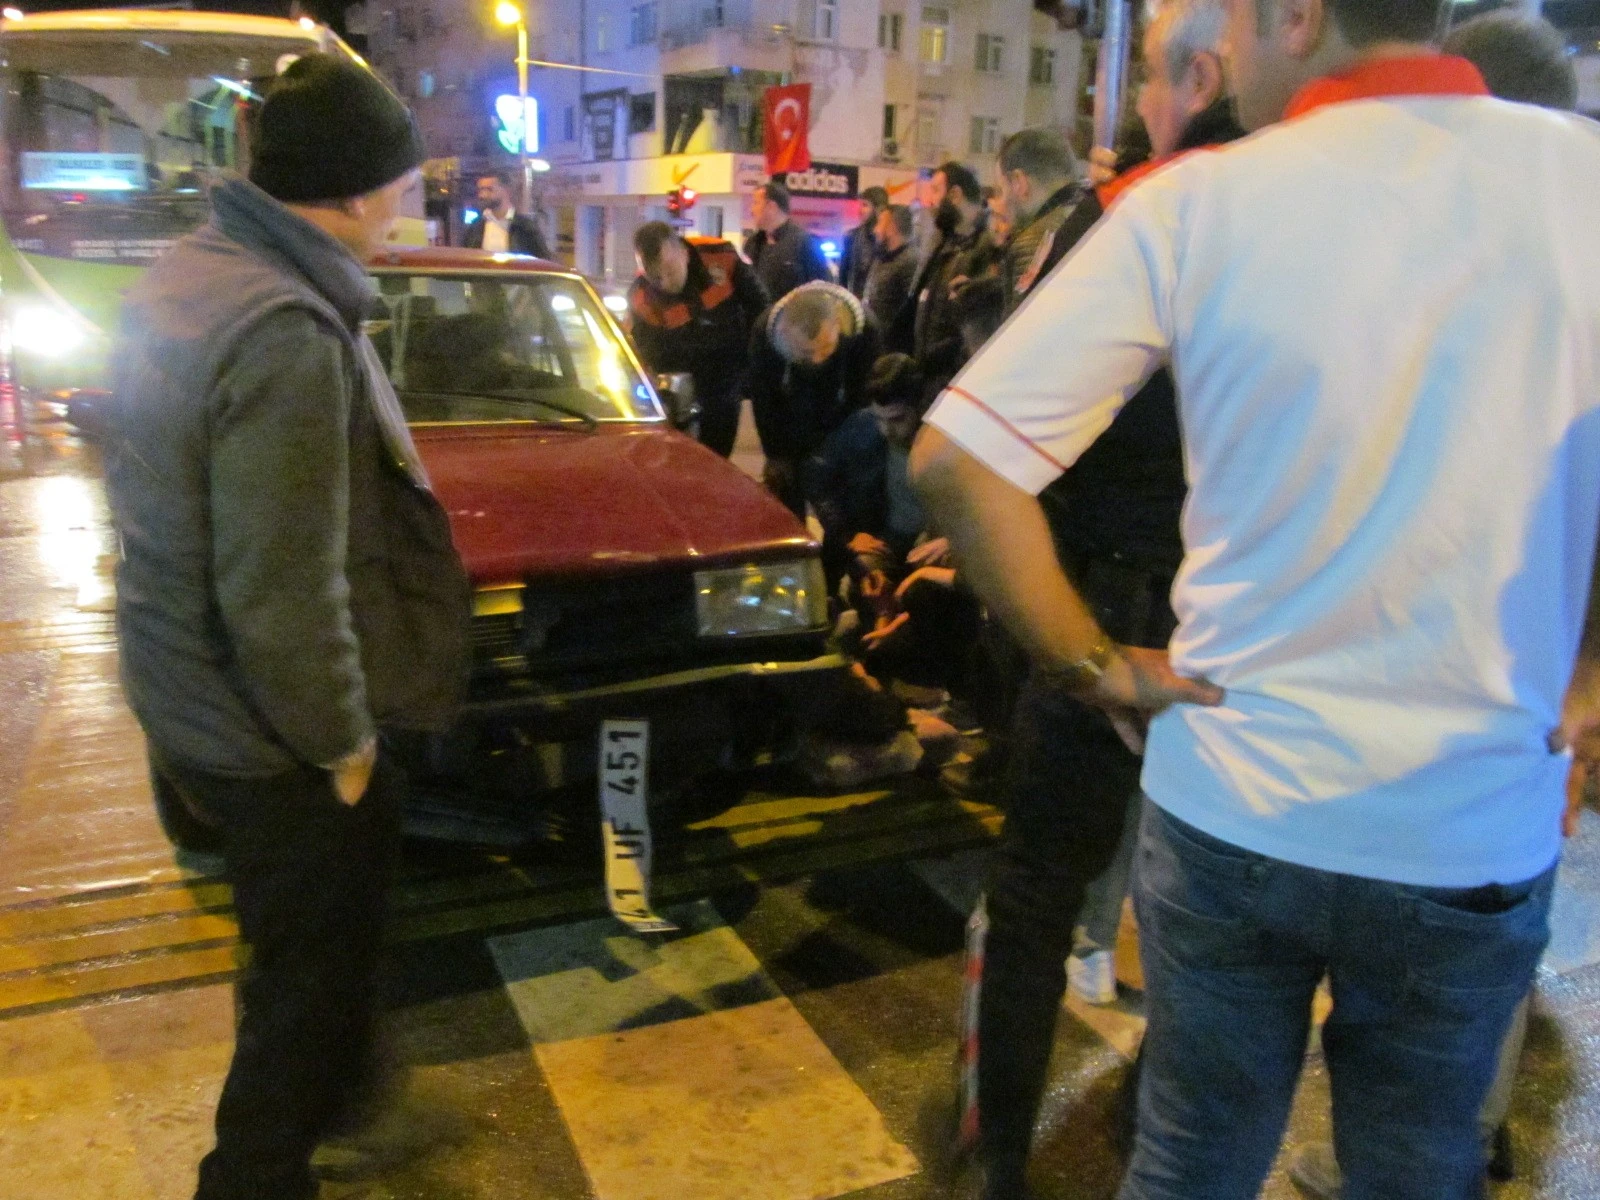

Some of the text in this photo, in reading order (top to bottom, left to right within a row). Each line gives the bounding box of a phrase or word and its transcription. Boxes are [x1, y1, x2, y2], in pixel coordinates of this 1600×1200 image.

[786, 167, 849, 194] adidas
[606, 729, 643, 795] 451
[610, 816, 645, 860] UF
